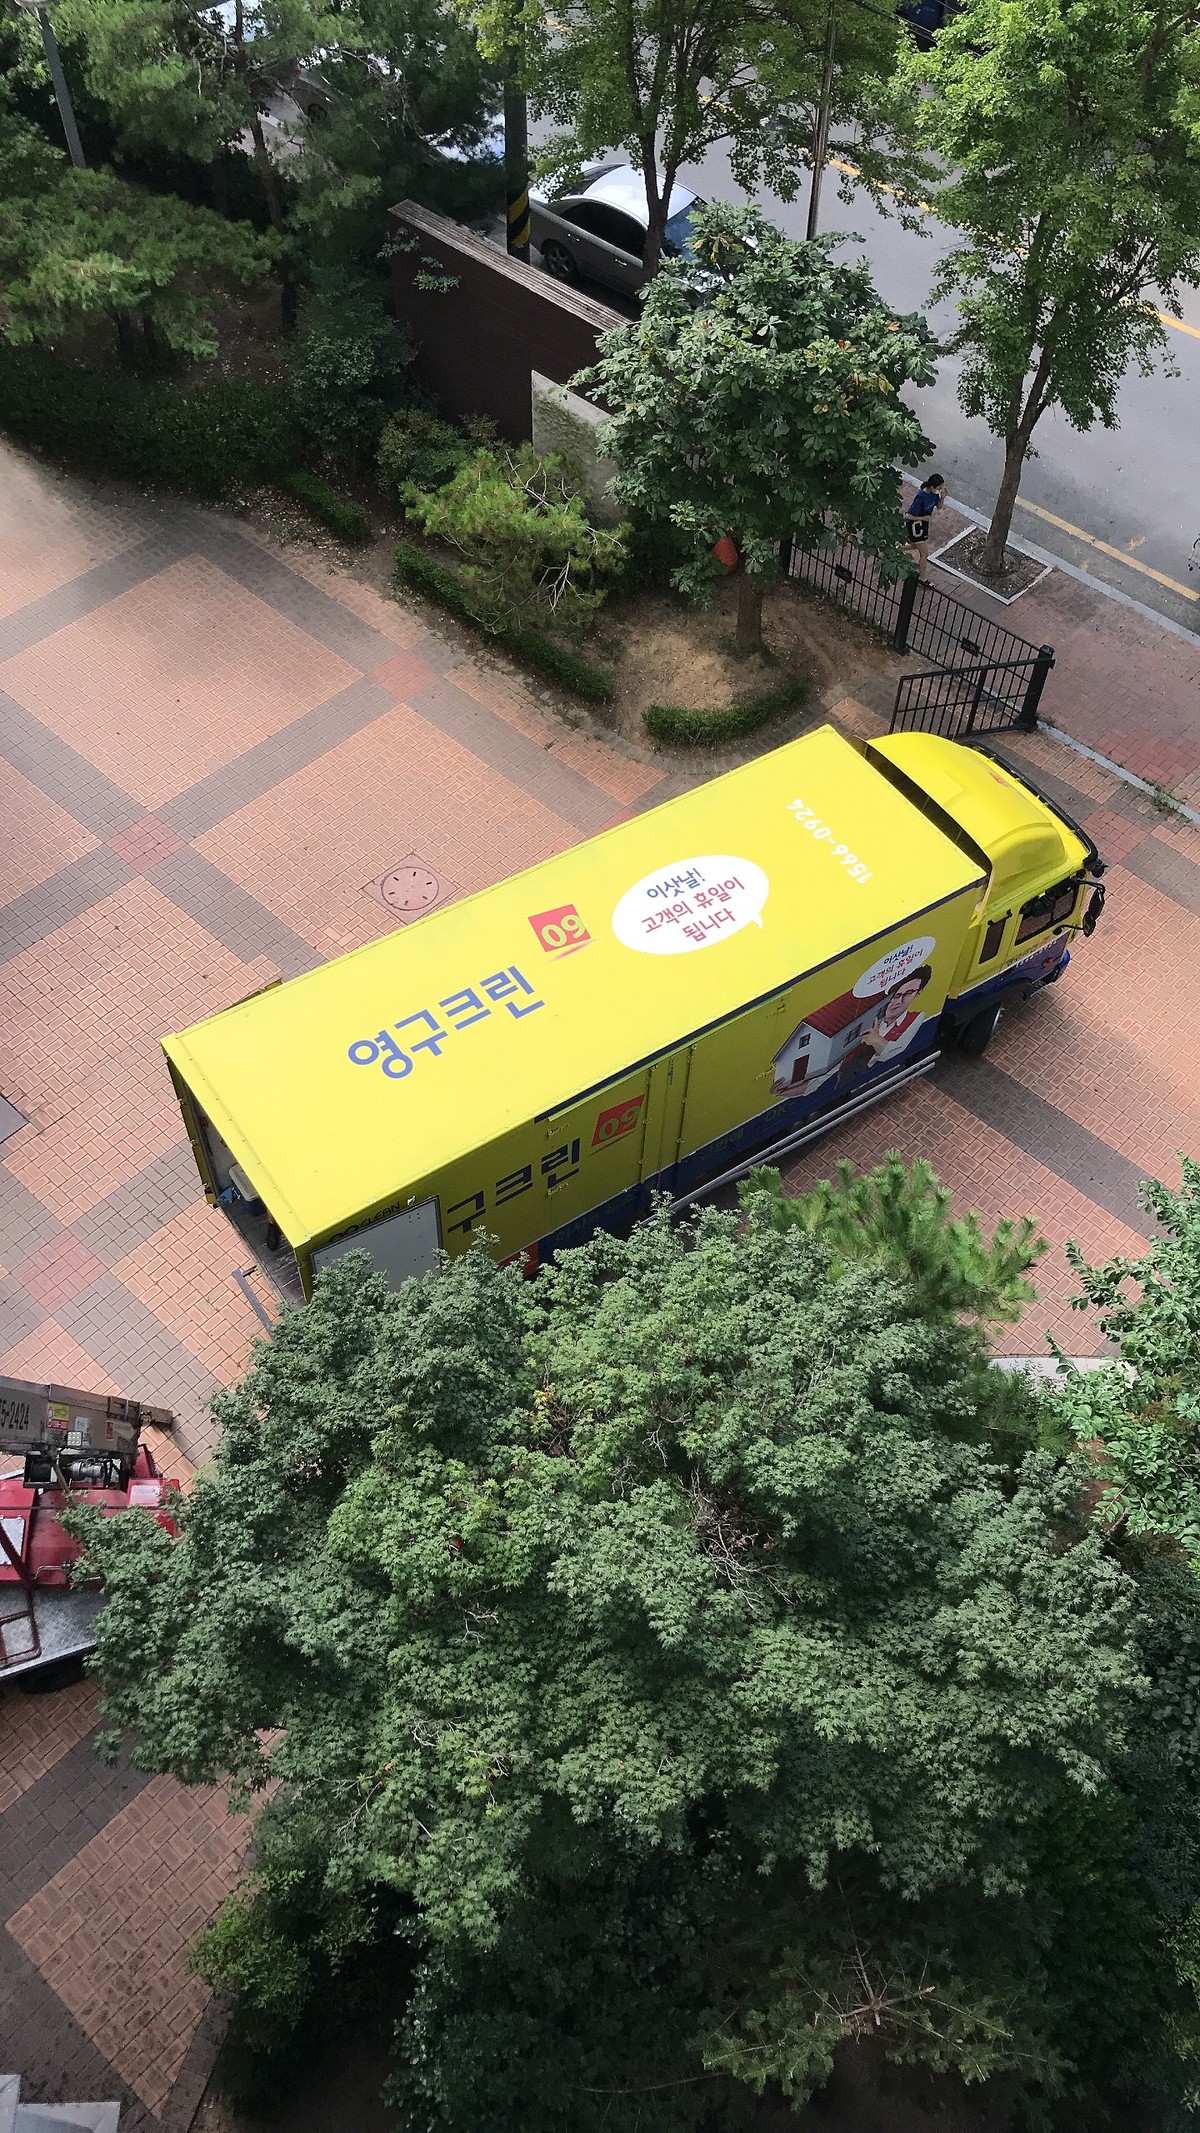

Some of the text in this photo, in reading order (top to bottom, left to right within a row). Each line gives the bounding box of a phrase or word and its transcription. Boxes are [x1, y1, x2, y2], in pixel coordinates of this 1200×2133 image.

[786, 798, 874, 884] 1566-0924
[646, 867, 706, 898] 이삿날!
[641, 876, 745, 934] 고객의 휴일이
[682, 907, 736, 942] 됩니다
[883, 944, 914, 965] 이삿날!
[347, 914, 586, 1079] 영구크린 09
[598, 1106, 641, 1140] 09
[0, 1399, 30, 1431] 5-2424
